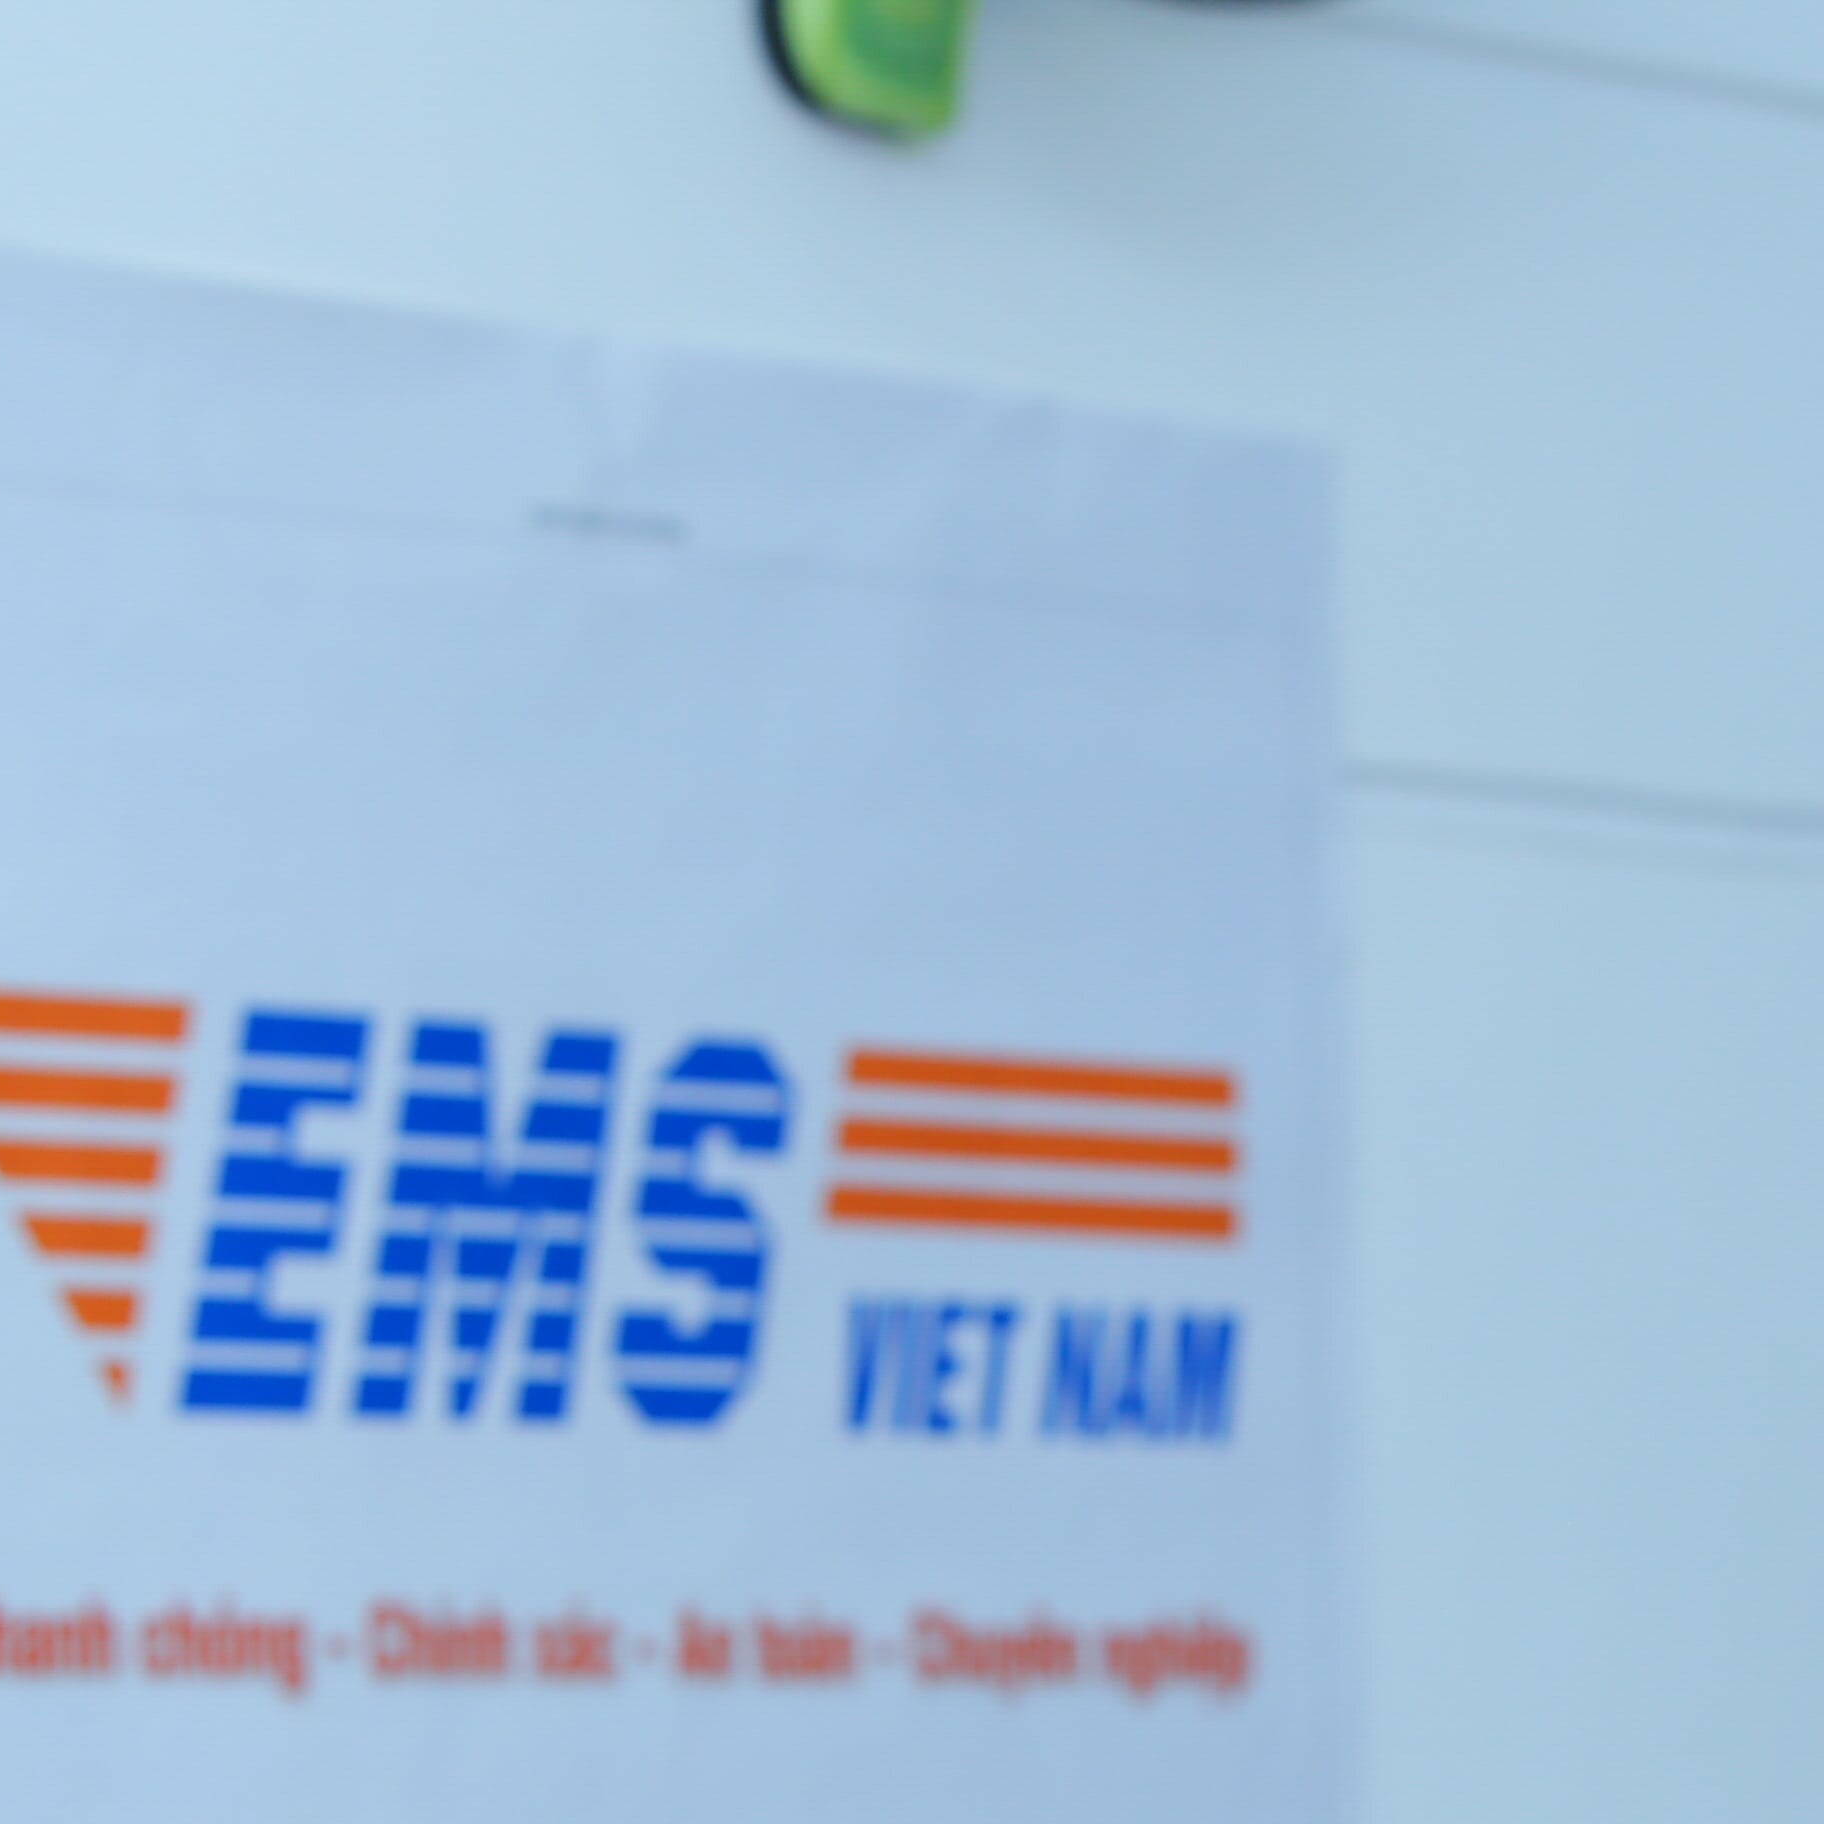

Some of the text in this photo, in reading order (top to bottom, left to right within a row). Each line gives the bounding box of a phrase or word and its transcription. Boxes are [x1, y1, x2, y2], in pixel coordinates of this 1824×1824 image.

[176, 1006, 793, 1427] EMS
[846, 1296, 1238, 1443] VIET NAM
